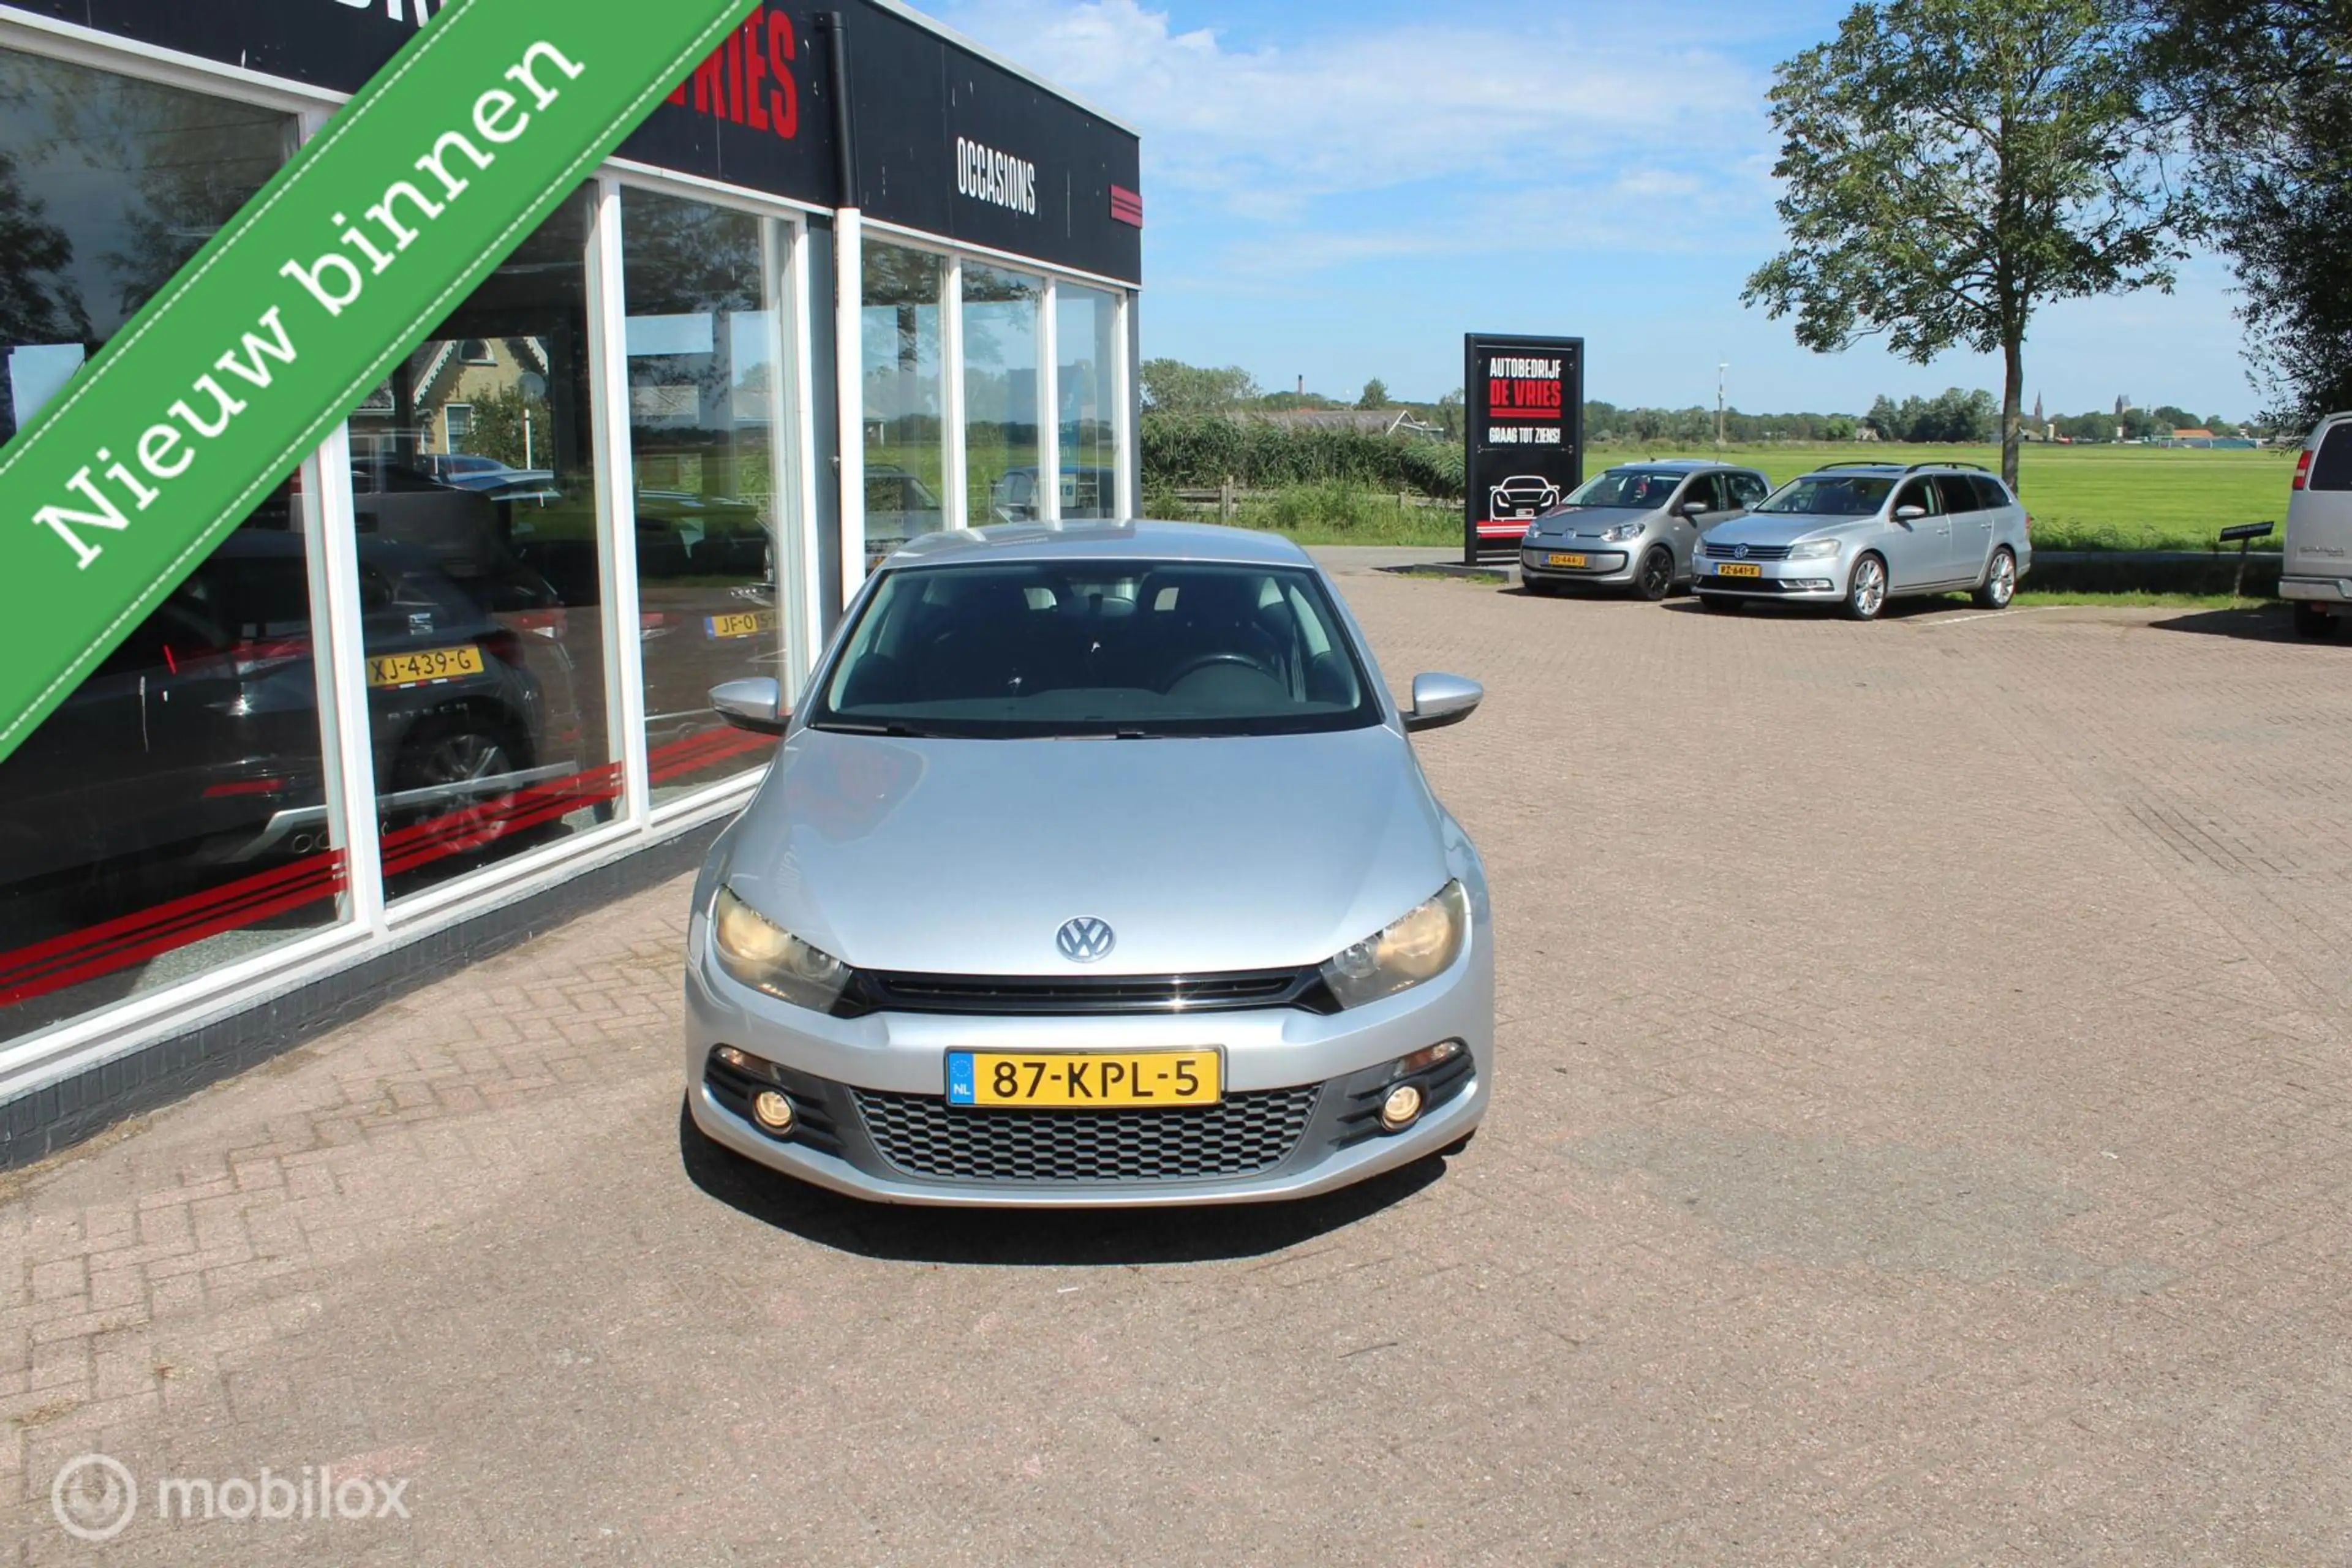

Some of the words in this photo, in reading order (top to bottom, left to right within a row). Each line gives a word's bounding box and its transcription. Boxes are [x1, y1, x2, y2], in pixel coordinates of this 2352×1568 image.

[957, 136, 1035, 216] OCCASIONS
[1490, 358, 1561, 379] AUTOBEDRIJF
[1490, 379, 1509, 405] DE
[1513, 380, 1561, 407] VRIES
[1489, 427, 1518, 443] GRAAG
[1519, 428, 1533, 443] TOT
[1534, 428, 1561, 443] ZIENS!
[371, 649, 471, 682] XJ-439-G
[953, 1082, 971, 1096] NL
[993, 1060, 1199, 1098] 87-KPL-5
